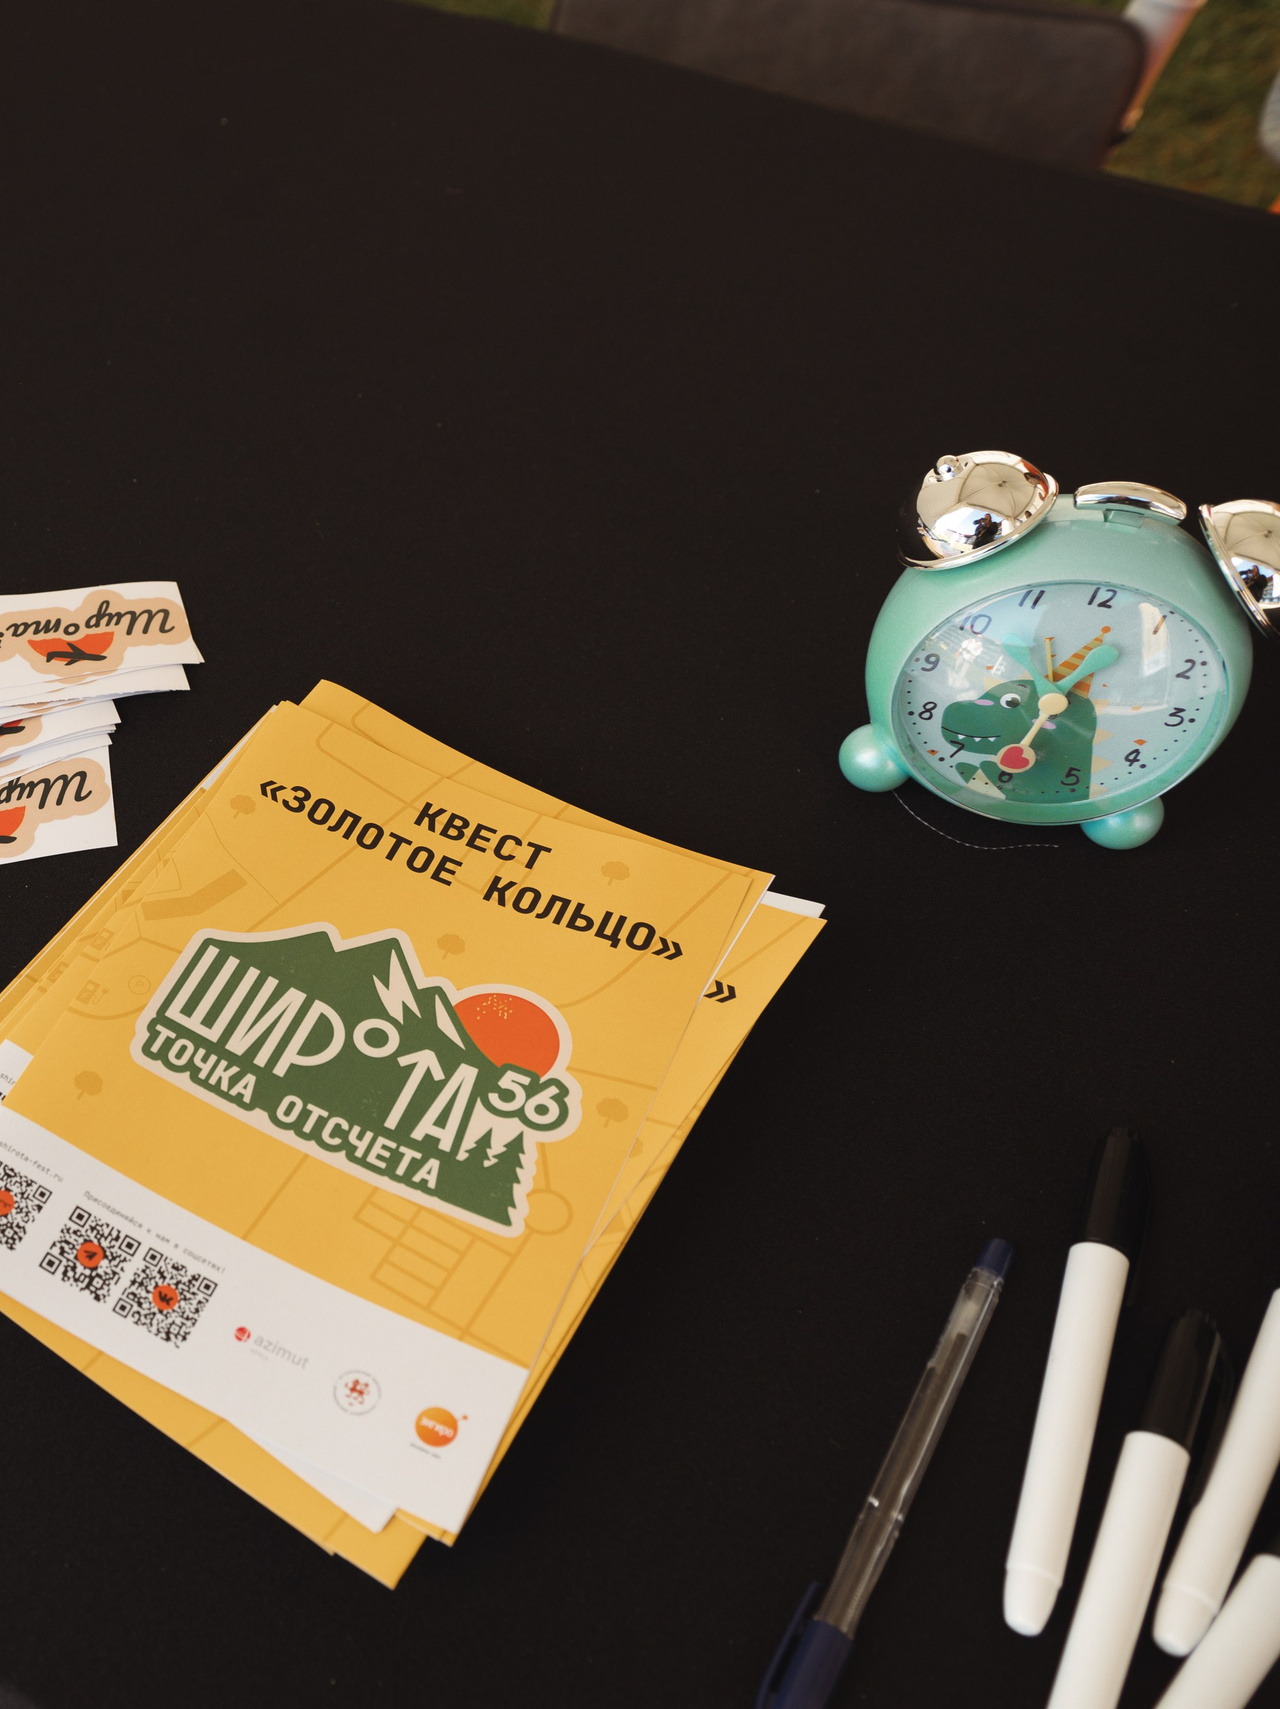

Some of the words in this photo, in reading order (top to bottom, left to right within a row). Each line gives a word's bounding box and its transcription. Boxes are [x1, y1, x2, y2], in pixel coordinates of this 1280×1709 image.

[1018, 589, 1045, 609] 11
[1088, 587, 1117, 609] 12
[959, 612, 992, 634] 10
[1152, 615, 1166, 635] 1
[921, 653, 940, 672] 9
[1176, 659, 1196, 679] 2
[918, 701, 937, 720] 8
[1164, 708, 1186, 727] 3
[950, 740, 965, 758] 7
[1124, 749, 1141, 766] 4
[1061, 766, 1081, 786] 5
[414, 801, 552, 870] КВЕСТ
[260, 779, 463, 886] «ЗОЛОТОЕ
[482, 875, 683, 961] КОЛЬЦО»
[149, 1024, 257, 1104] ТОЧКА
[275, 1094, 440, 1190] ОТСЧЕТА
[253, 1333, 310, 1370] azimut
